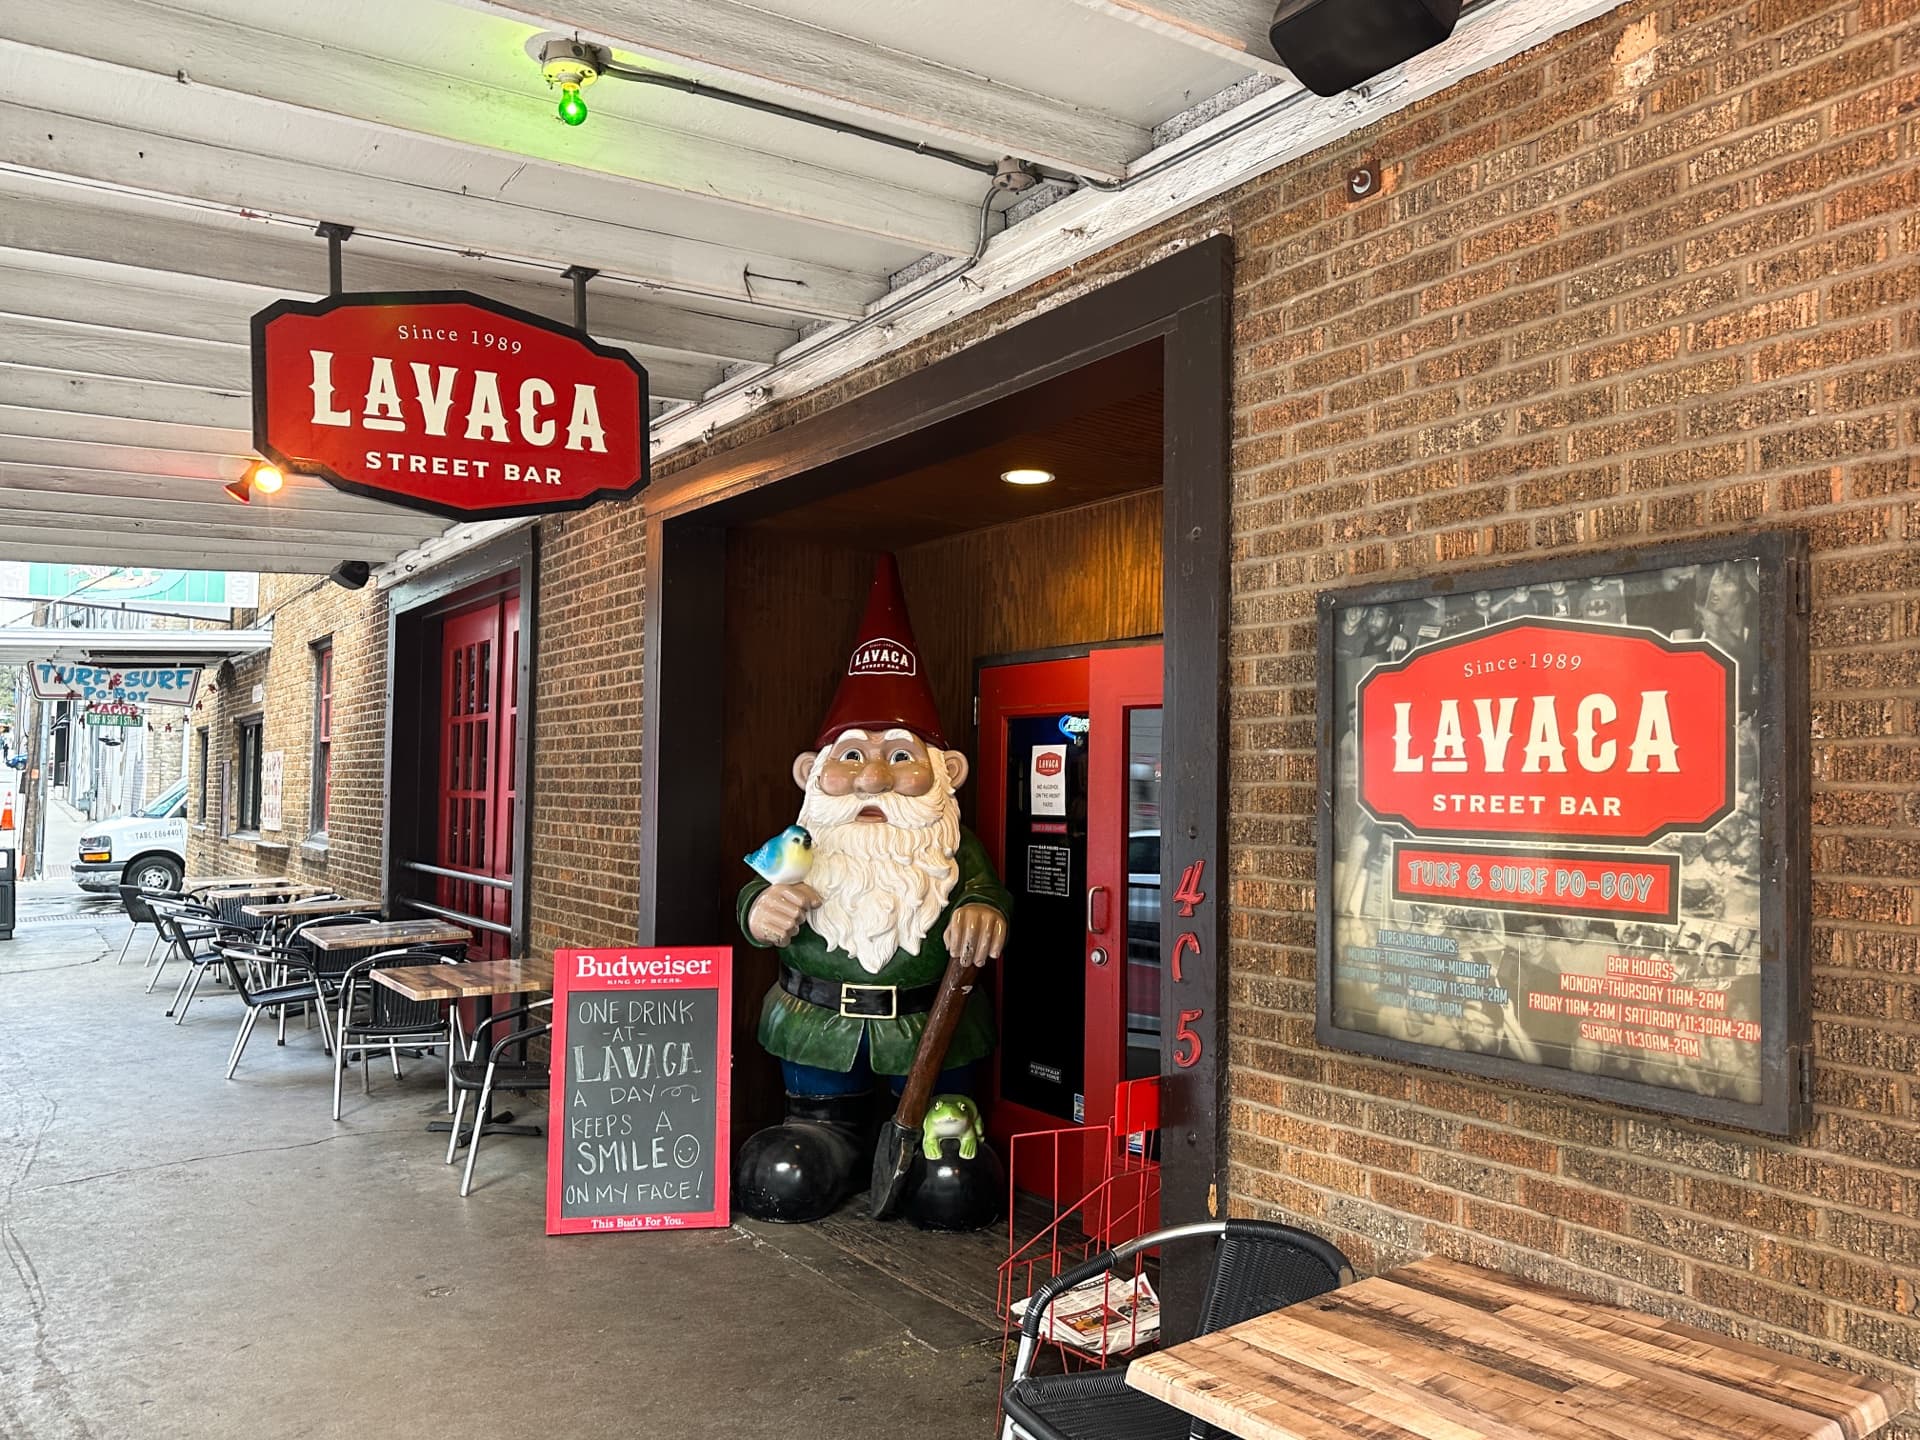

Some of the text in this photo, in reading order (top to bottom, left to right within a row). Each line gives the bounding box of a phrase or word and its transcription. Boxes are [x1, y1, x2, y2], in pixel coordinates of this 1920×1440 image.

[398, 325, 523, 354] Since 1989
[308, 350, 609, 454] LAVACA
[366, 452, 562, 485] STREET BAR
[855, 649, 908, 667] LAVACA
[1463, 653, 1583, 678] Since 1989
[36, 664, 111, 686] TURF
[124, 669, 193, 690] SURF
[1392, 690, 1681, 773] LAVACA
[1038, 759, 1059, 769] LAVACA
[1433, 794, 1622, 816] STREET BAR
[1408, 860, 1654, 903] TURF & SURF PO-BOY
[1426, 936, 1459, 953] HOURS:
[575, 955, 712, 978] Budweiser
[1607, 956, 1675, 981] BAR HOURS:
[1408, 974, 1448, 995] SATURDAY
[1449, 982, 1509, 1004] 11:30AM-2AM
[1559, 974, 1726, 1011] MONDAY-THURSDAY 11AM-2AM
[578, 998, 695, 1026] ONE DRINK
[1528, 992, 1563, 1011] FRIDAY
[1565, 996, 1616, 1020] 11AM-2AM
[1624, 1005, 1683, 1031] SATURDAY
[1581, 1023, 1700, 1057] SUNDAY 11:30AM-2AM
[573, 1084, 656, 1108] A DAY
[570, 1110, 673, 1139] KEEPS A
[577, 1136, 668, 1176] SMILE
[566, 1170, 704, 1205] ON MY FACE!
[591, 1215, 685, 1229] This Bud's For You.
